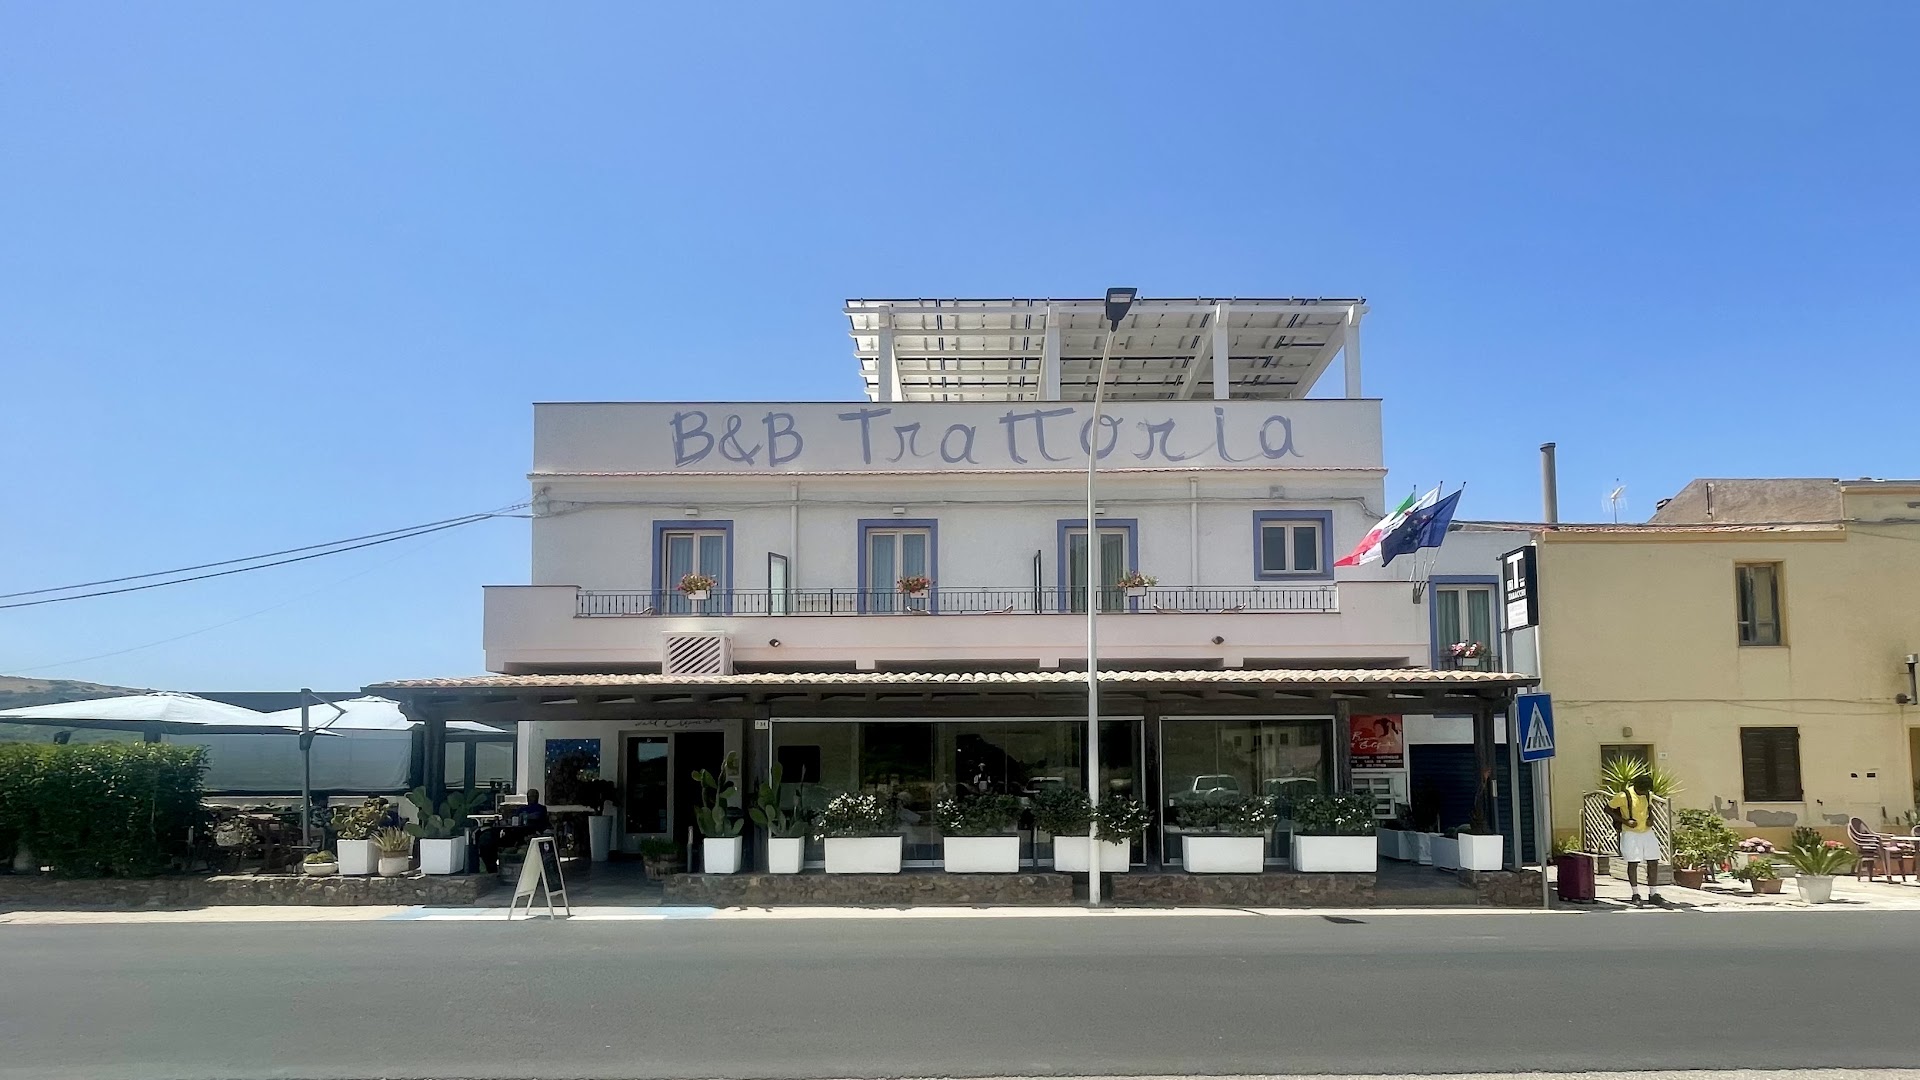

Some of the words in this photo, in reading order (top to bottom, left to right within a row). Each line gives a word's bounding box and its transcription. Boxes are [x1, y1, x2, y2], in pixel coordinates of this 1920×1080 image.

[669, 411, 804, 467] B&B
[837, 405, 1304, 465] Trattoria
[1507, 551, 1523, 589] T
